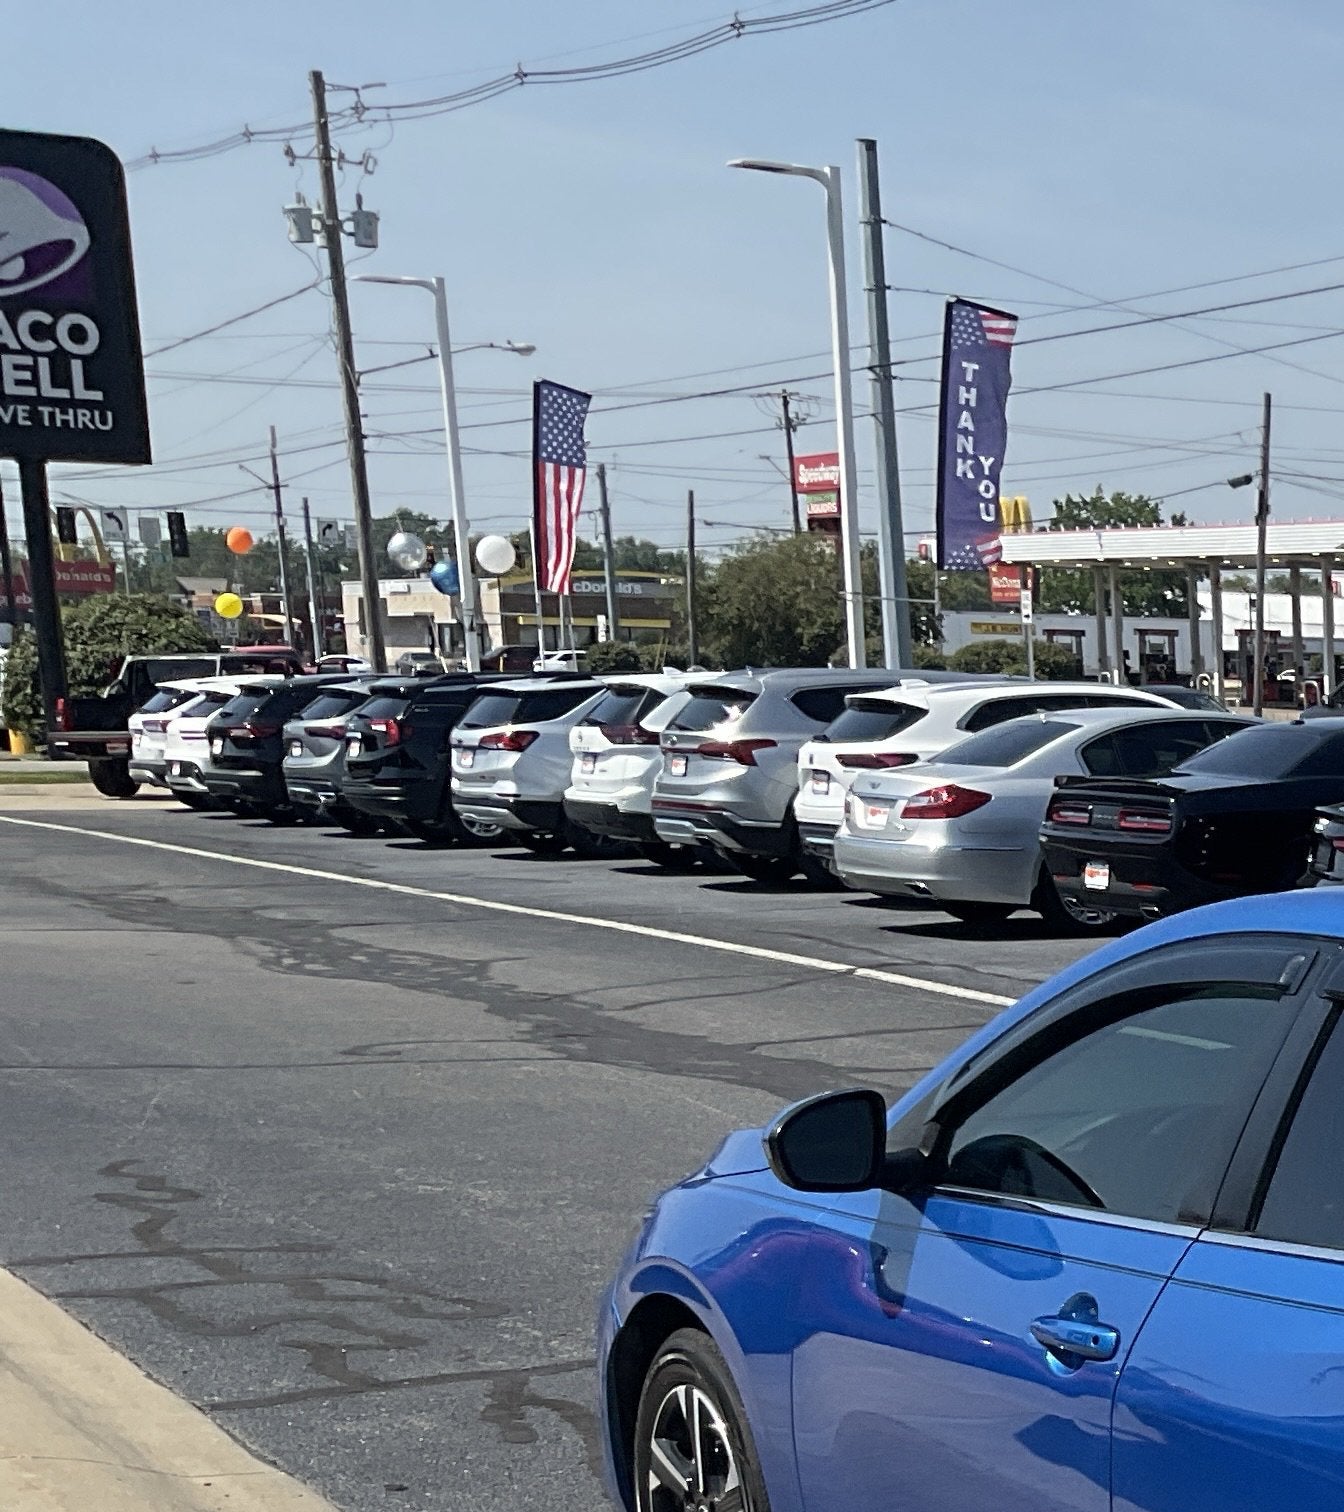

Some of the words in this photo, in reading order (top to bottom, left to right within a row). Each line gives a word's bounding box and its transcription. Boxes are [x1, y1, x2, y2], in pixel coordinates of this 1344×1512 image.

[38, 406, 113, 431] THRU
[956, 361, 979, 479] THANK
[979, 456, 996, 522] YOU
